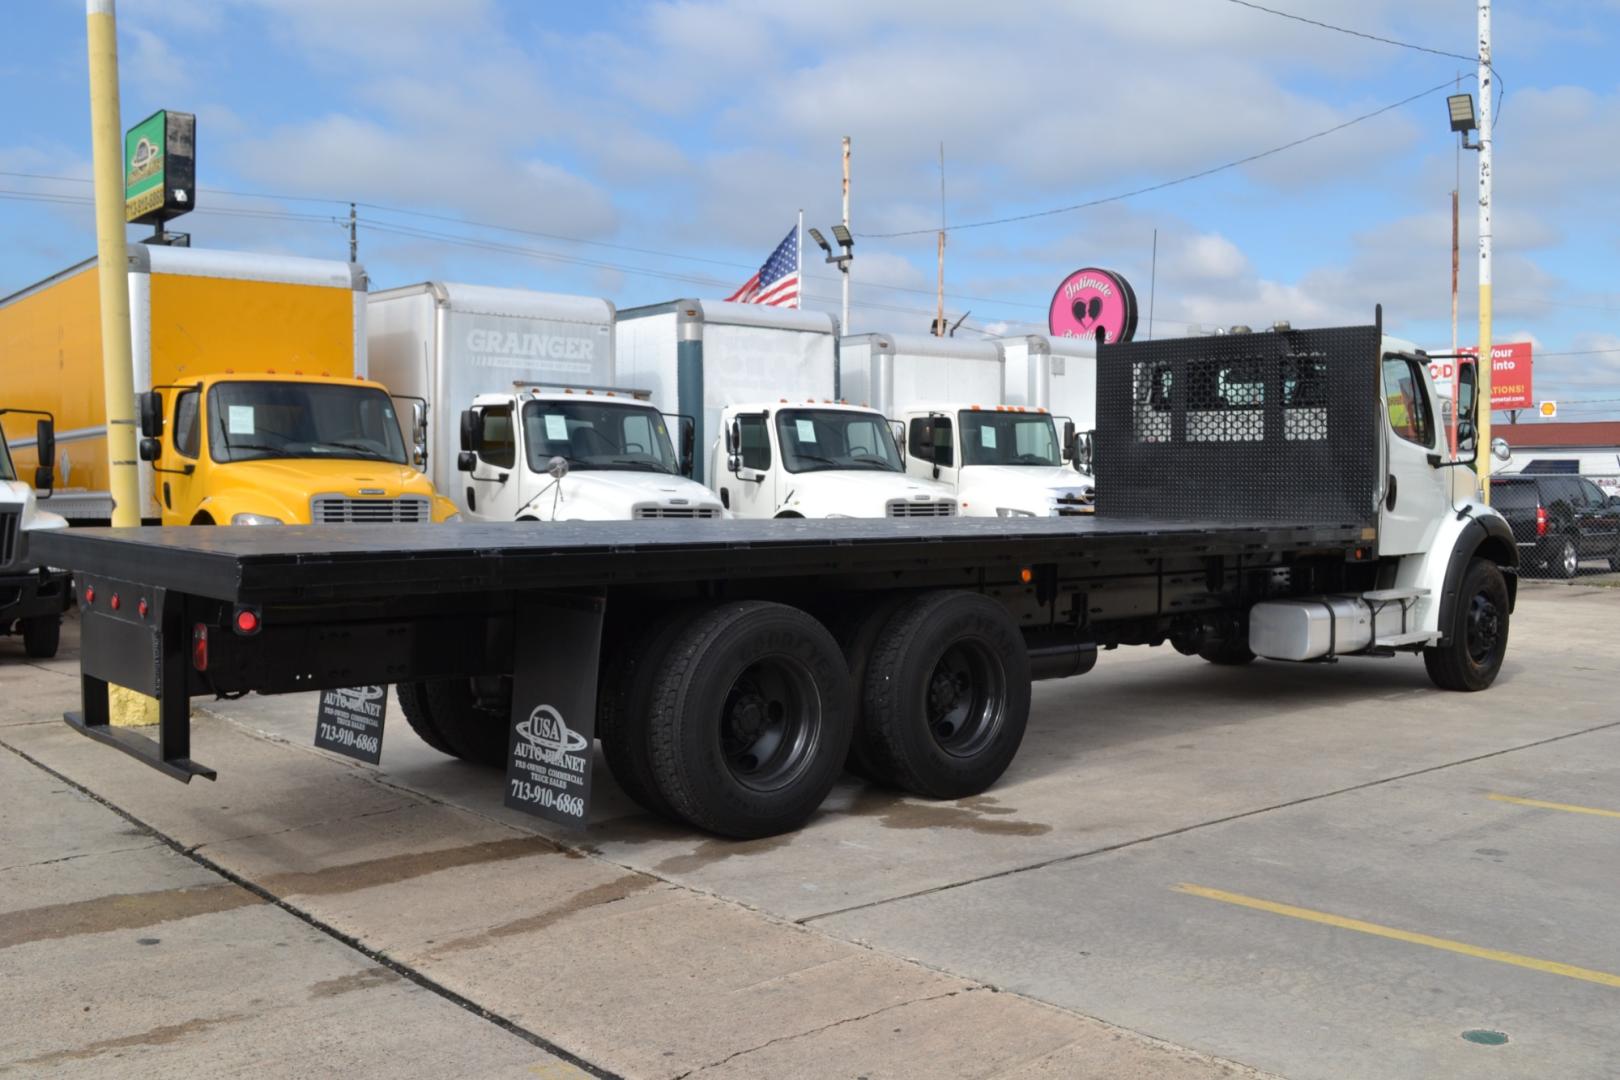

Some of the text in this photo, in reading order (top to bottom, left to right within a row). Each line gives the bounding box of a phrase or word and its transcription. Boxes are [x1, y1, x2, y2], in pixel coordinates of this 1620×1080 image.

[1065, 276, 1112, 300] Intimate
[467, 328, 594, 360] GRAINGER
[1493, 360, 1516, 370] into
[320, 723, 378, 754] 713-910-6868
[533, 716, 560, 740] USA
[531, 772, 567, 790] TRUCK SALES
[547, 768, 583, 786] COMMERCIAL
[511, 778, 584, 817] 713-910-6868
